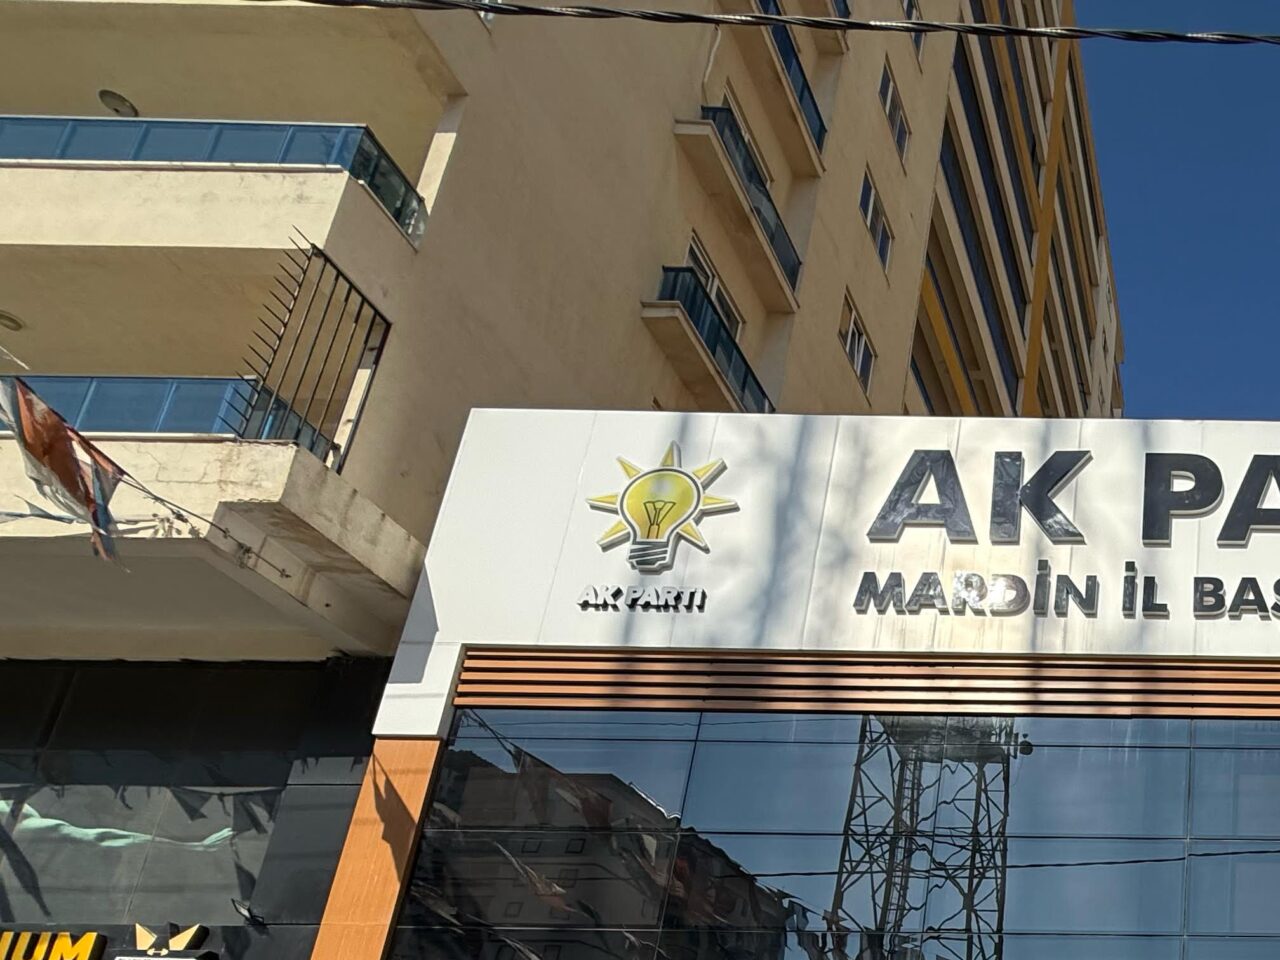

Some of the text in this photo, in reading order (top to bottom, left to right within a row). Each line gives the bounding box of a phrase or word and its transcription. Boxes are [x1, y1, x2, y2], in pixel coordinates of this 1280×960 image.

[866, 449, 1093, 545] AK
[577, 585, 624, 612] AK
[853, 559, 1100, 618] MARDİN
[1122, 560, 1170, 619] İL
